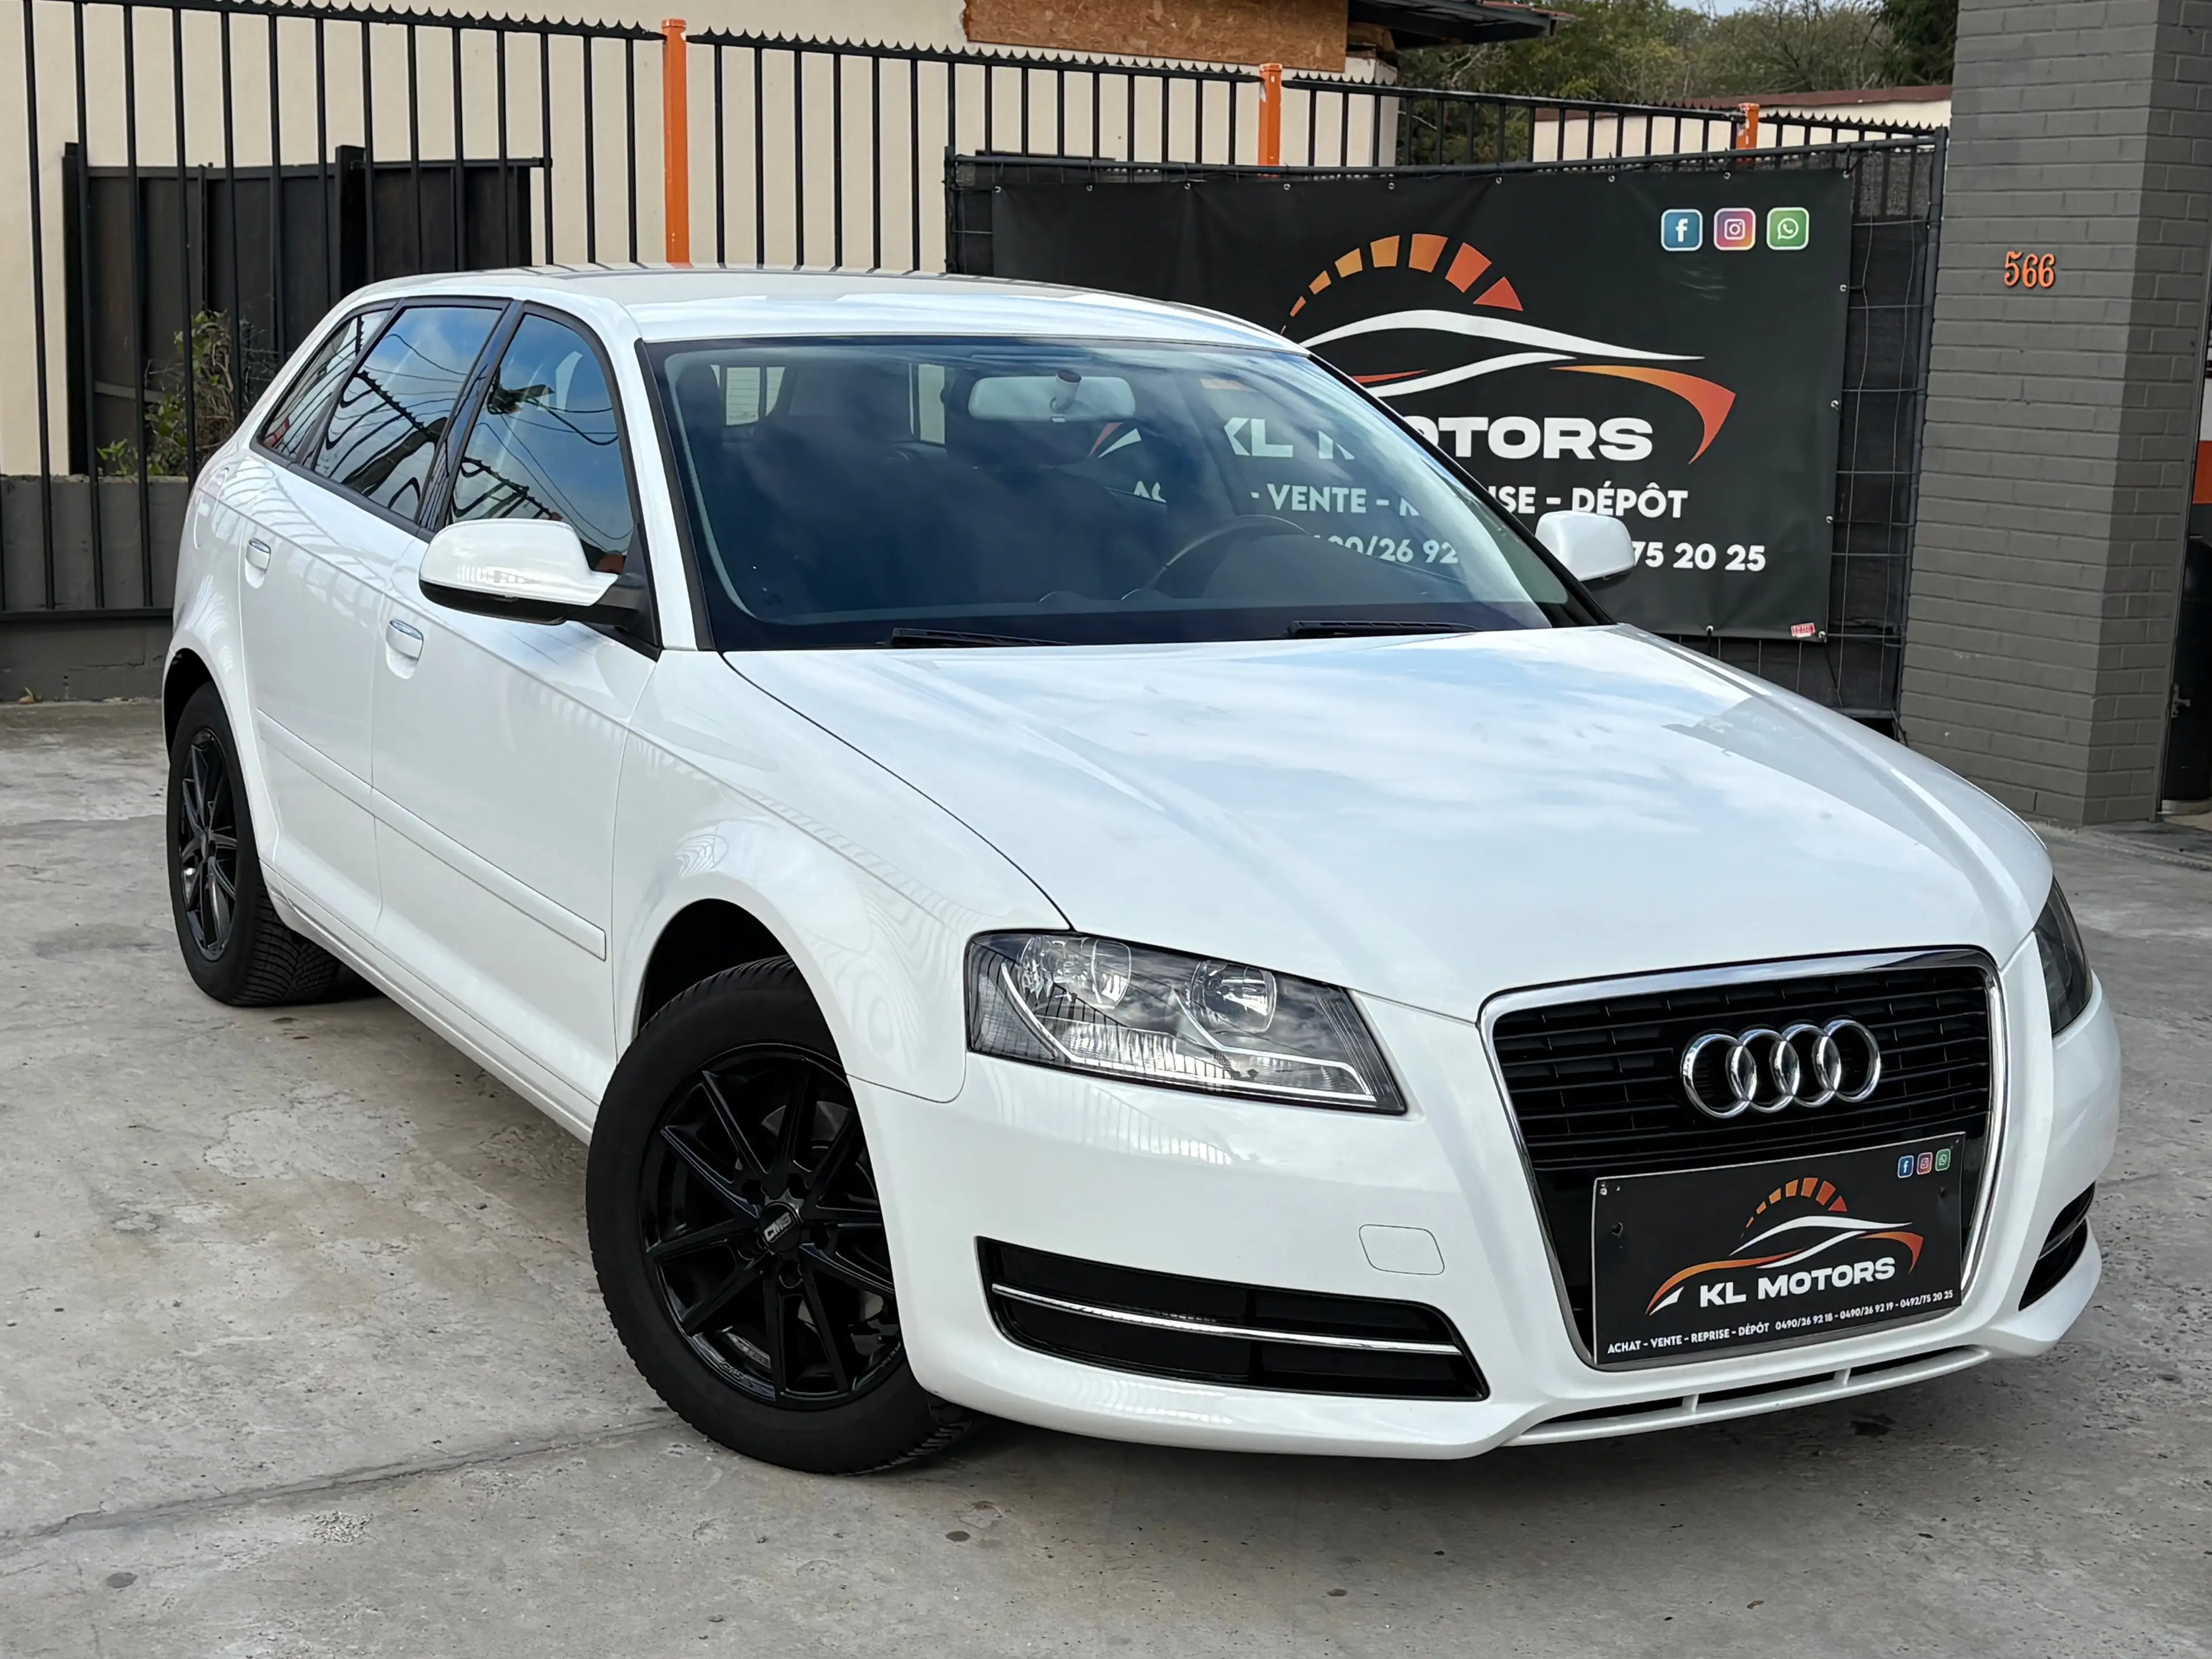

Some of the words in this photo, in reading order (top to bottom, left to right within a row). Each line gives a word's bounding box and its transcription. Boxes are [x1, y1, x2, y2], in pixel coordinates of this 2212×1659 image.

[2004, 251, 2055, 288] 566
[1267, 484, 1367, 513] VENTE
[1572, 479, 1688, 518] DÉPÔT
[1673, 542, 1717, 570] 20
[1725, 544, 1766, 572] 25
[764, 1211, 792, 1242] CMS
[1700, 1282, 1747, 1308] KL
[1758, 1257, 1896, 1300] MOTORS
[1607, 1340, 1642, 1354] ACHAT
[1650, 1335, 1683, 1349] VENTE
[1691, 1328, 1730, 1343] REPRISE
[1738, 1321, 1770, 1336] DÉPÔT
[1775, 1315, 1811, 1330] 0490/26
[1813, 1314, 1823, 1324] 92
[1840, 1305, 1873, 1320] 0490/26
[1875, 1304, 1885, 1313] 92
[1900, 1293, 1931, 1308] 0492/75
[1933, 1292, 1942, 1302] 20
[1944, 1290, 1953, 1299] 25
